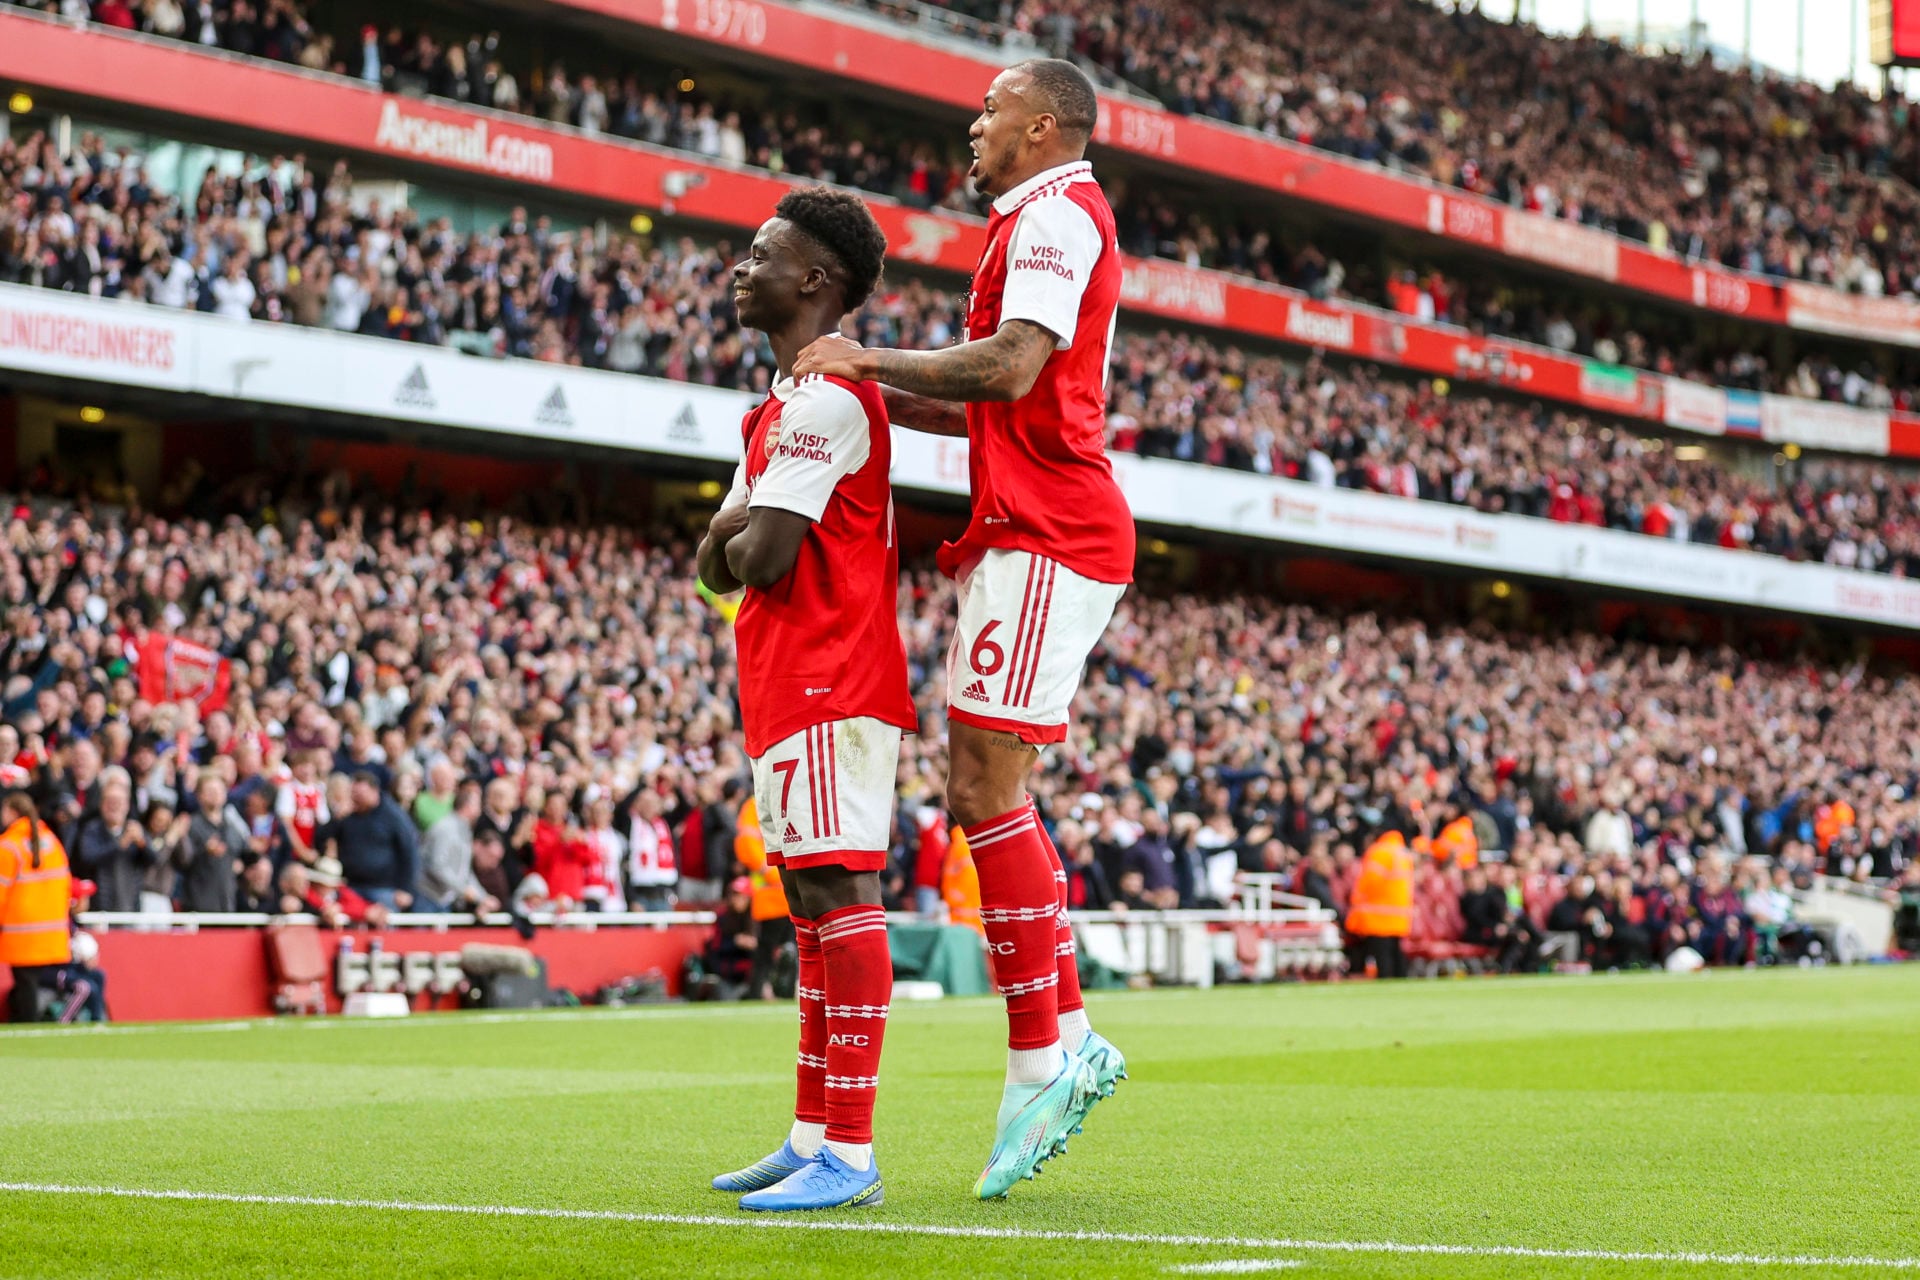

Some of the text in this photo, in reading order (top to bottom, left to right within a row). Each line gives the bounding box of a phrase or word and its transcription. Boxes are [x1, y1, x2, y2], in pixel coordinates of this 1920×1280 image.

[375, 99, 554, 183] Arsenal.com
[1030, 245, 1065, 261] VISIT
[1014, 258, 1074, 281] RWANDA
[792, 431, 829, 449] VISIT
[779, 445, 832, 464] RWANDA
[970, 619, 1004, 676] 6
[962, 689, 990, 703] adidas
[772, 758, 800, 818] 7
[783, 834, 803, 844] adidas
[829, 1033, 870, 1047] AFC
[852, 1179, 882, 1205] balance
